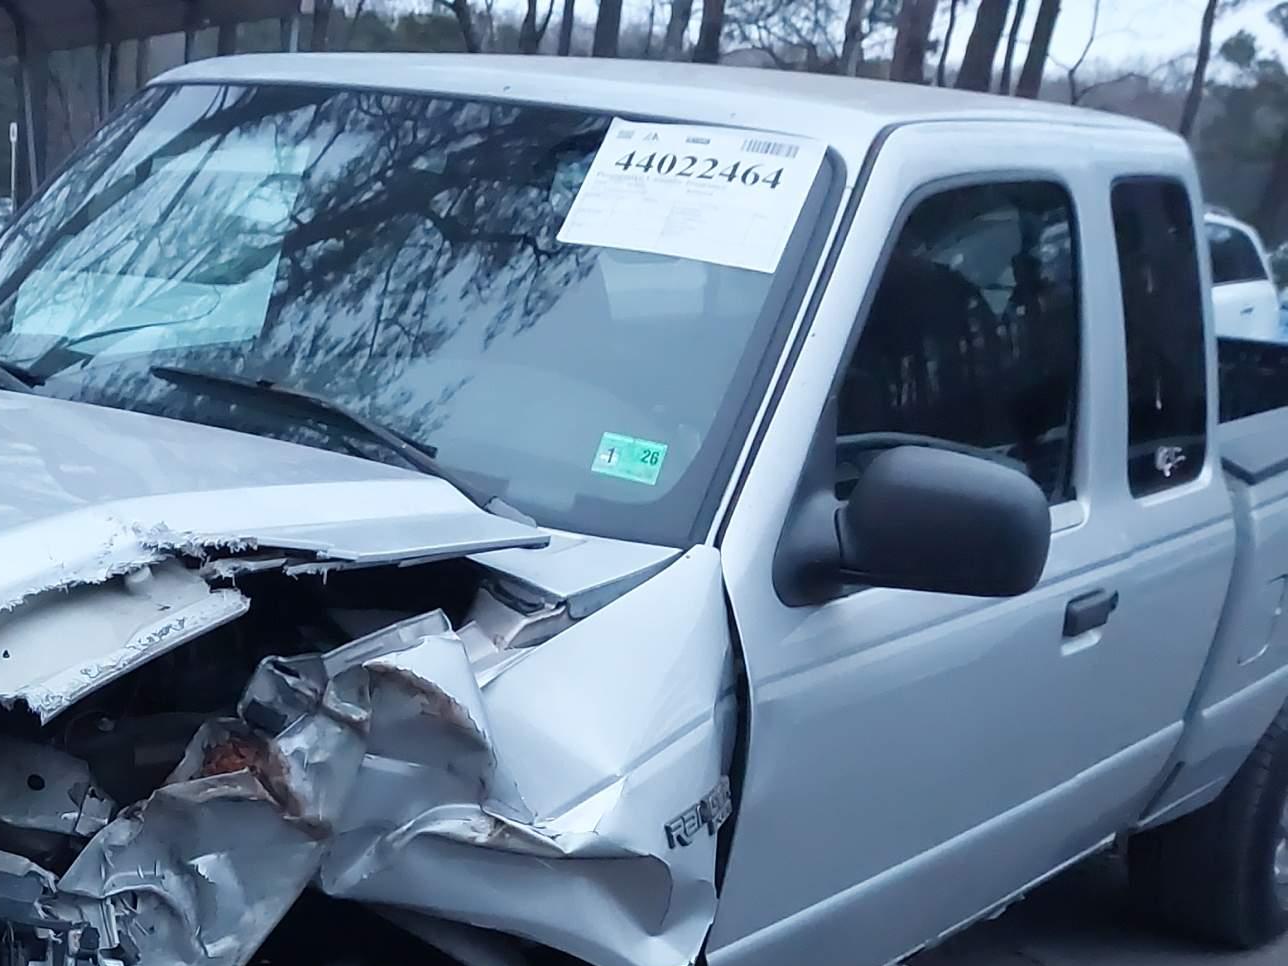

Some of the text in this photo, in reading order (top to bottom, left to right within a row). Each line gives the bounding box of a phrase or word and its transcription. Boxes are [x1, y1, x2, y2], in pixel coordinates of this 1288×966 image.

[614, 149, 785, 190] 44022464
[607, 447, 660, 466] 1 26
